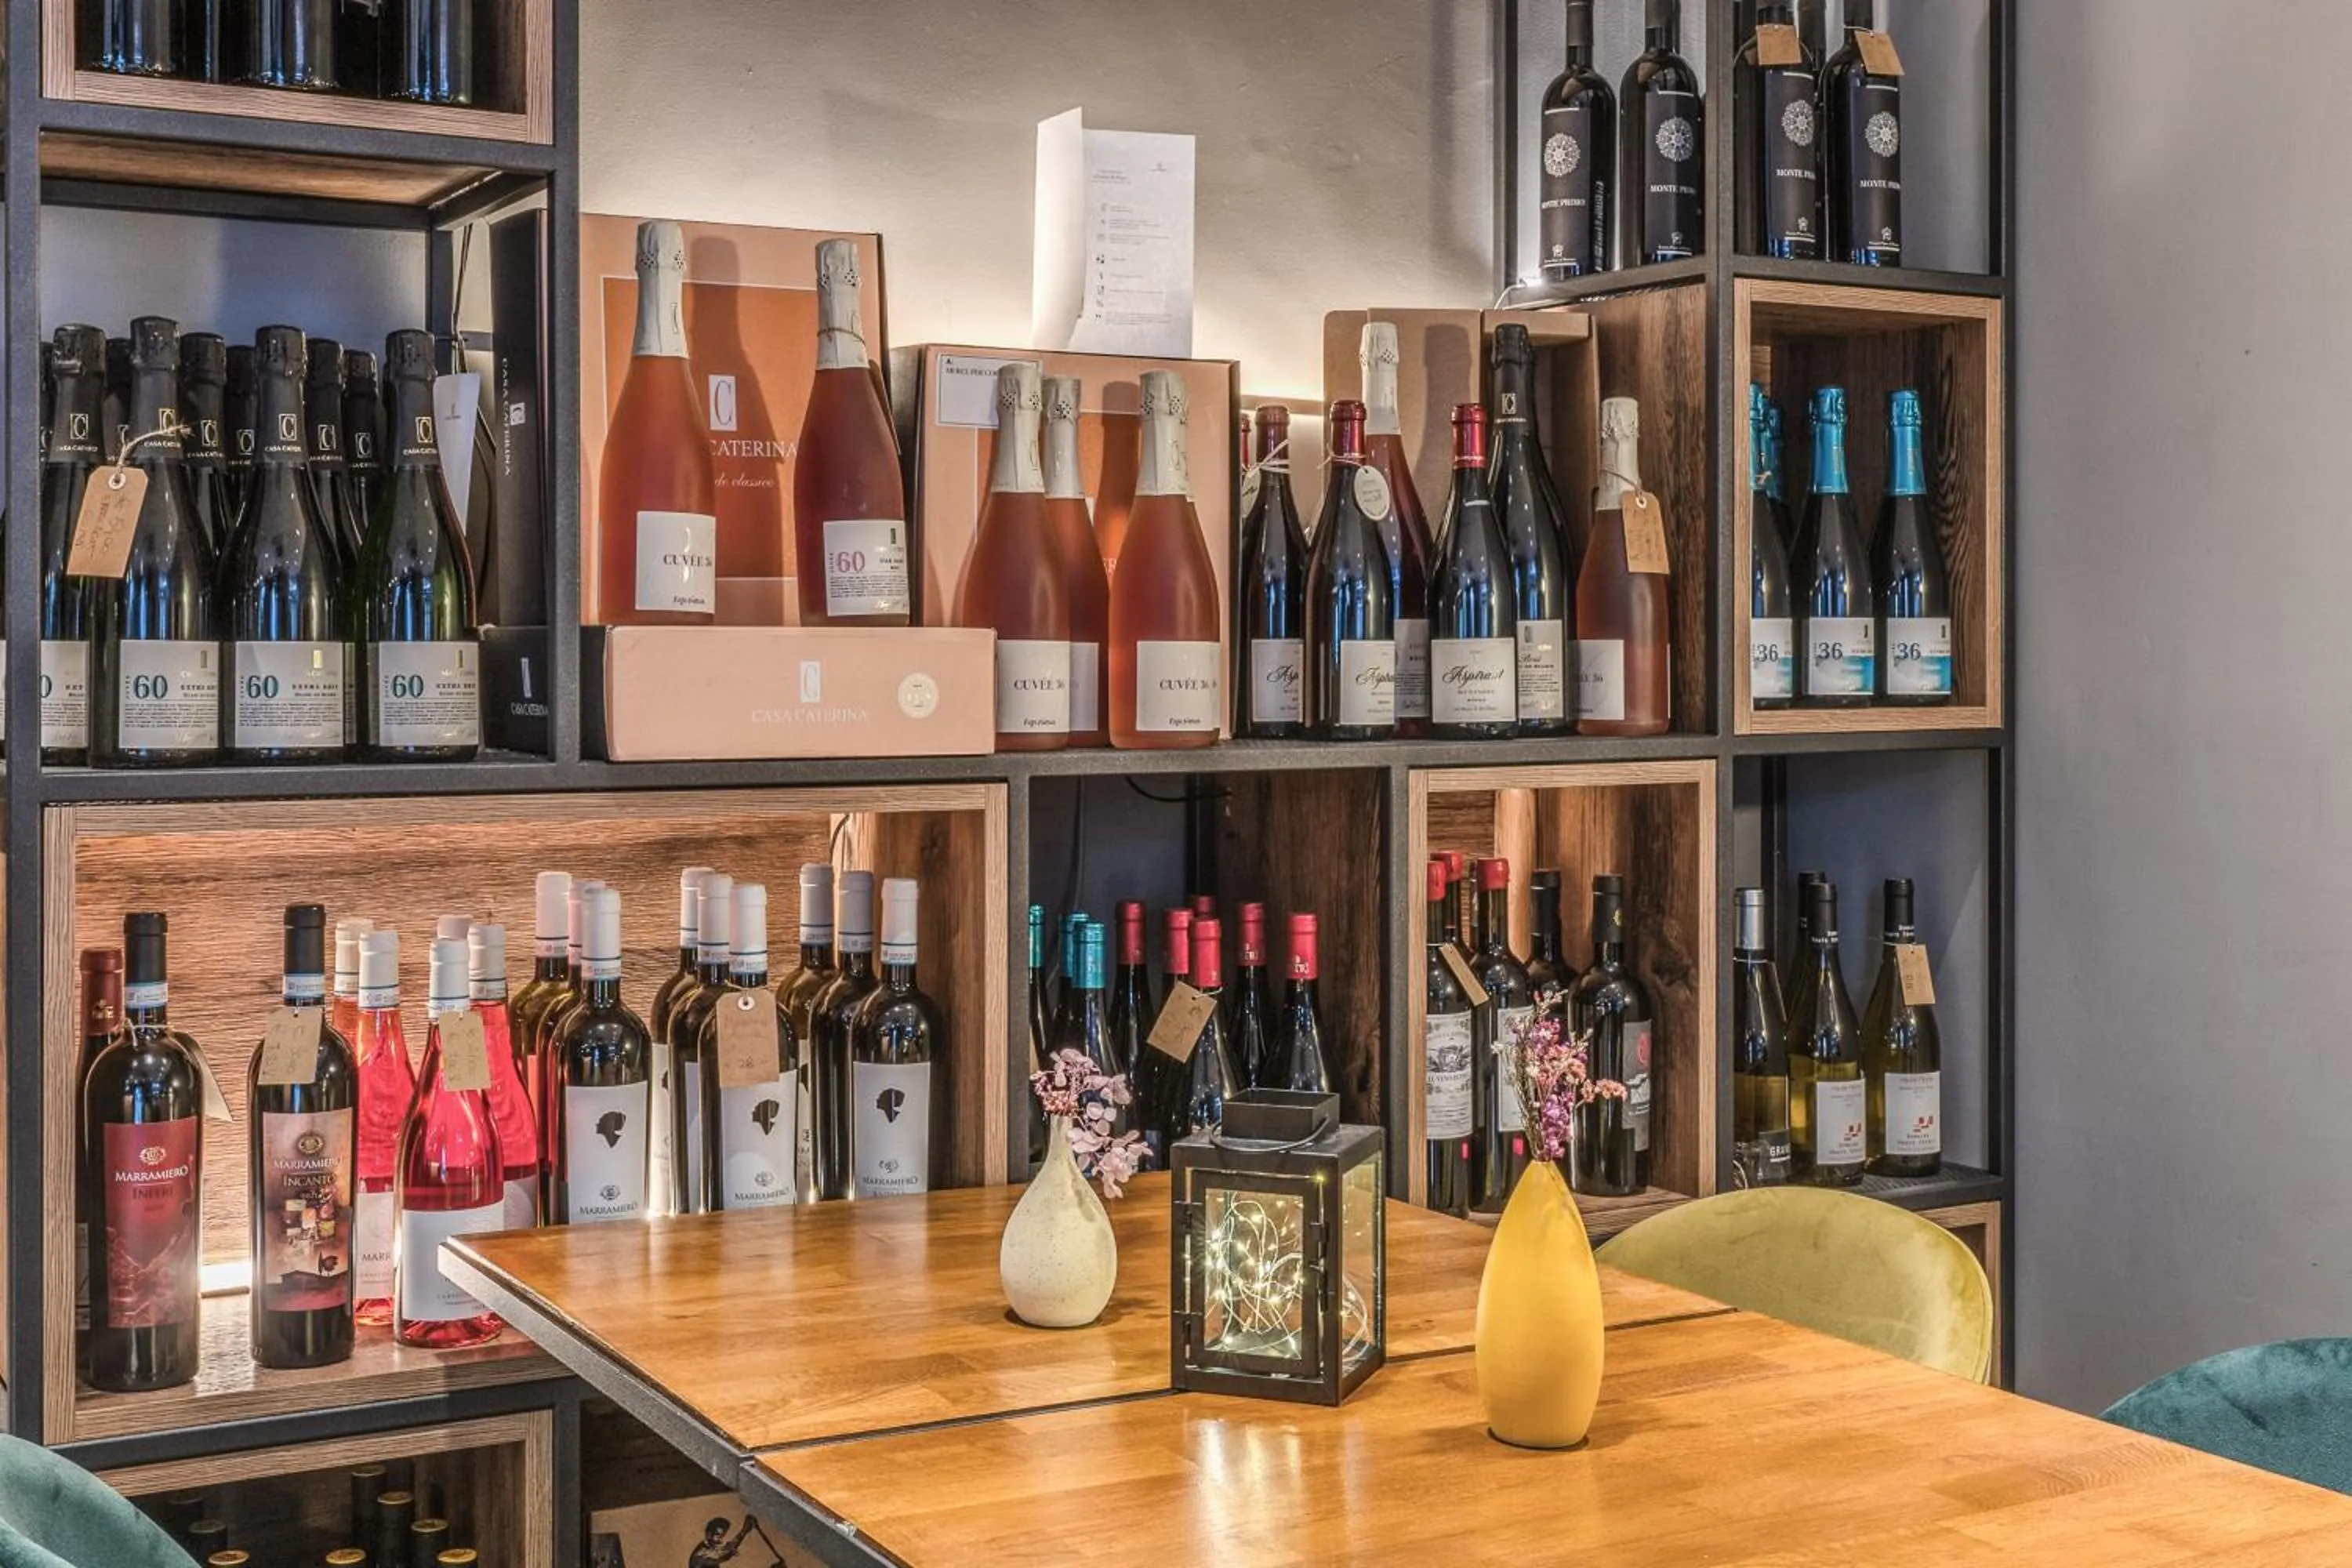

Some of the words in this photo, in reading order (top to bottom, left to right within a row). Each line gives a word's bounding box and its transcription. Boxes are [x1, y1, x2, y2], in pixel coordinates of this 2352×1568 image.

[837, 550, 866, 573] 60
[1756, 644, 1779, 662] 36
[1818, 642, 1842, 661] 36
[1897, 643, 1922, 661] 36
[132, 674, 169, 699] 60
[246, 674, 279, 699] 60
[392, 674, 424, 699] 60
[115, 1165, 189, 1182] MARRAMIERO
[283, 1174, 336, 1188] INCANTO
[579, 1202, 639, 1215] MARRAMIERO
